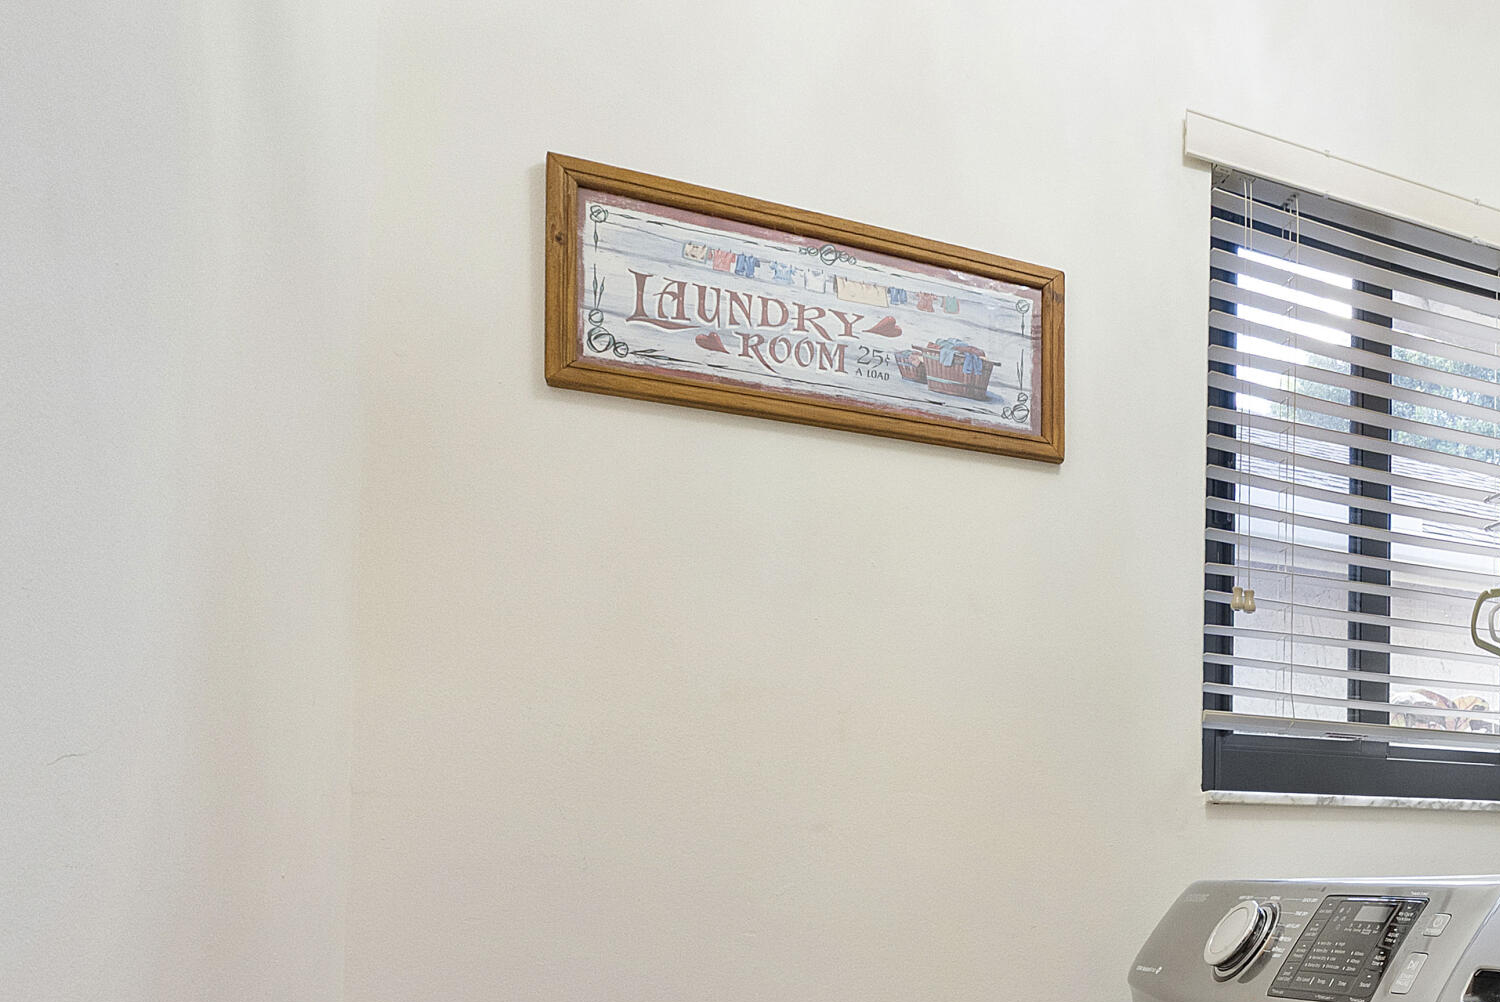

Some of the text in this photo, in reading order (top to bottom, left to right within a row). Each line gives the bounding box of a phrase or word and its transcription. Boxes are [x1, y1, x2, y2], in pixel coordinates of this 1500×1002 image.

[626, 268, 866, 342] LAUNDRY
[737, 331, 849, 375] ROOM
[856, 343, 892, 368] 25¢
[855, 368, 891, 382] A LOAD
